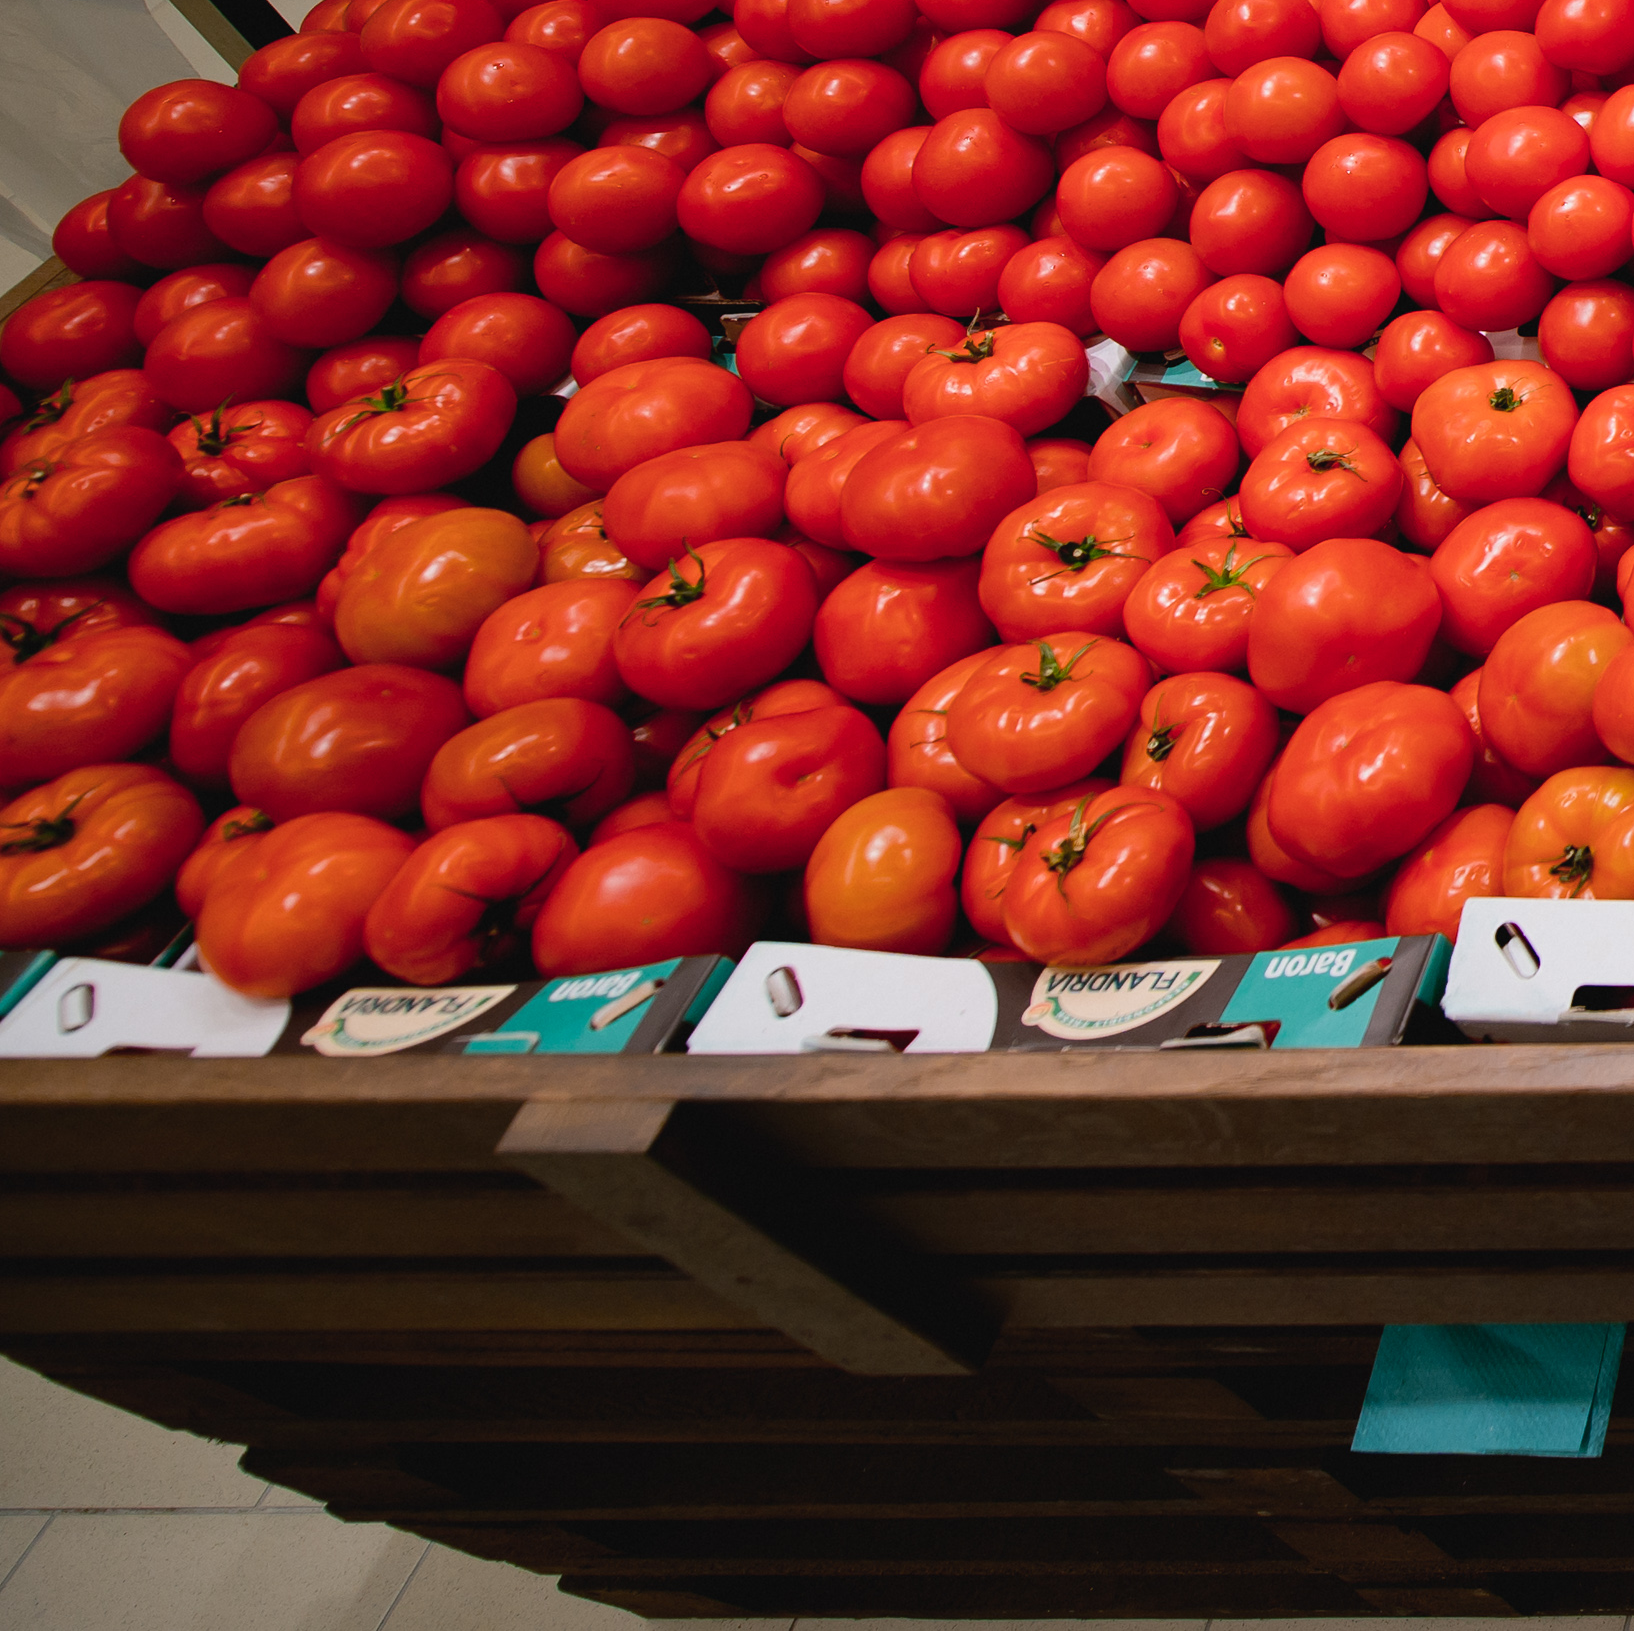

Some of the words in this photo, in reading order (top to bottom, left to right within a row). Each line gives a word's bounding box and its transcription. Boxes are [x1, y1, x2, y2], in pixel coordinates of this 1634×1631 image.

[1263, 947, 1357, 980] Baron
[548, 969, 644, 1003] Baron
[1046, 971, 1180, 993] FLANDRIA
[341, 994, 475, 1016] FLANDRIA
